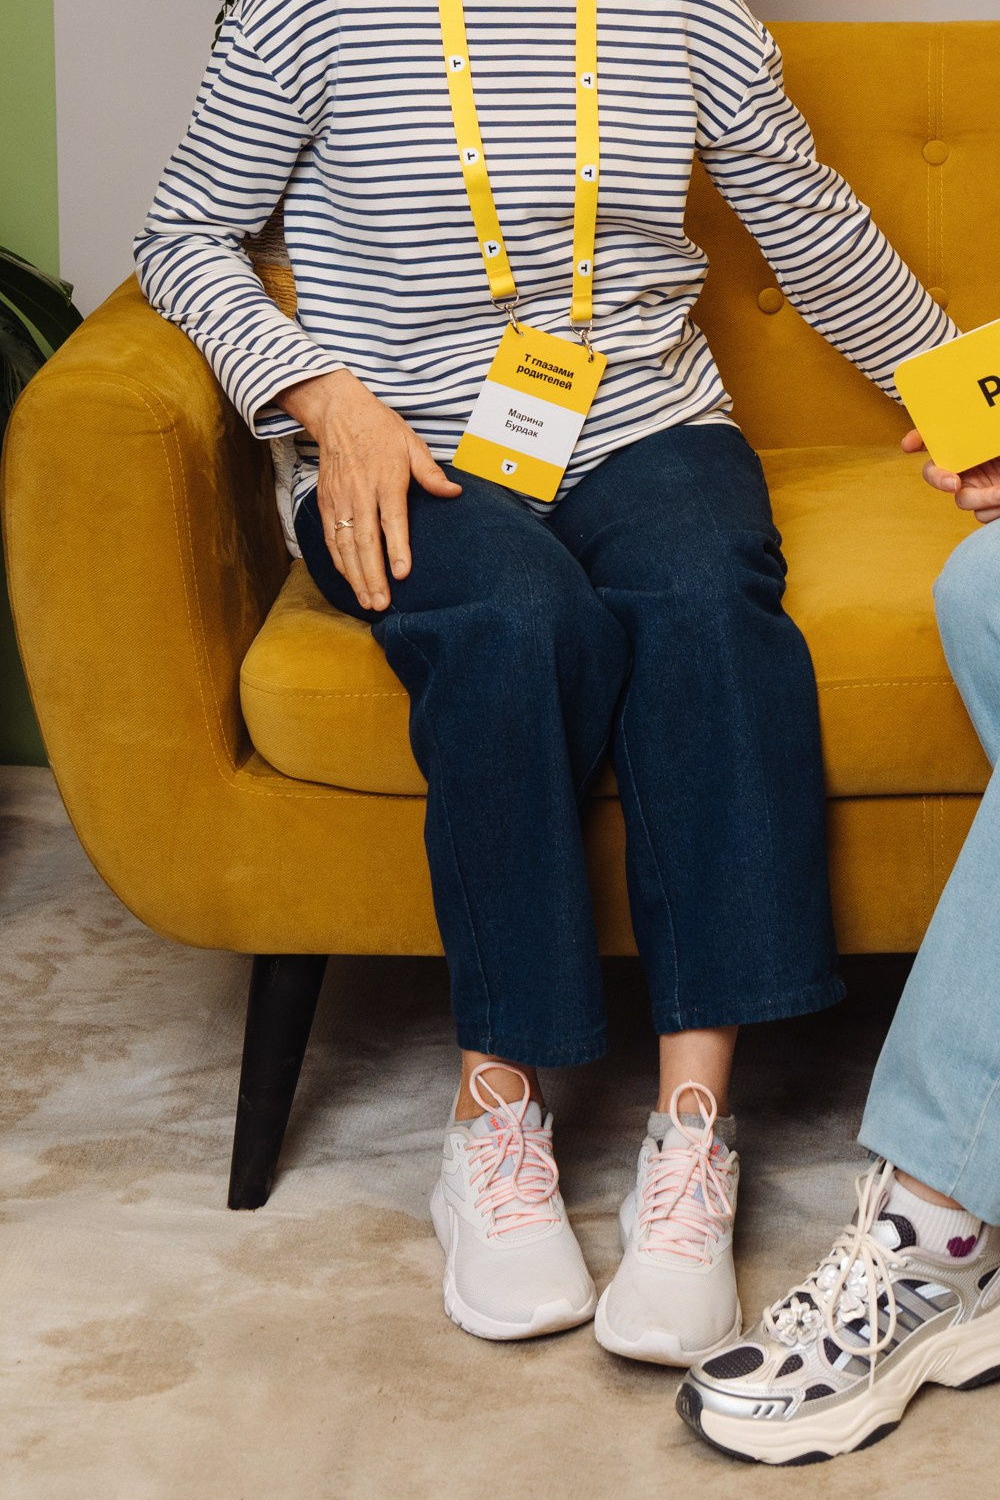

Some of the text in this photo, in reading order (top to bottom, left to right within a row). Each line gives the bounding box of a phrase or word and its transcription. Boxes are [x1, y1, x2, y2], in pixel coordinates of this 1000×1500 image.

[524, 353, 575, 379] Т глазами
[516, 365, 573, 391] родителей
[504, 419, 539, 438] Бурдак
[507, 408, 544, 428] Марина
